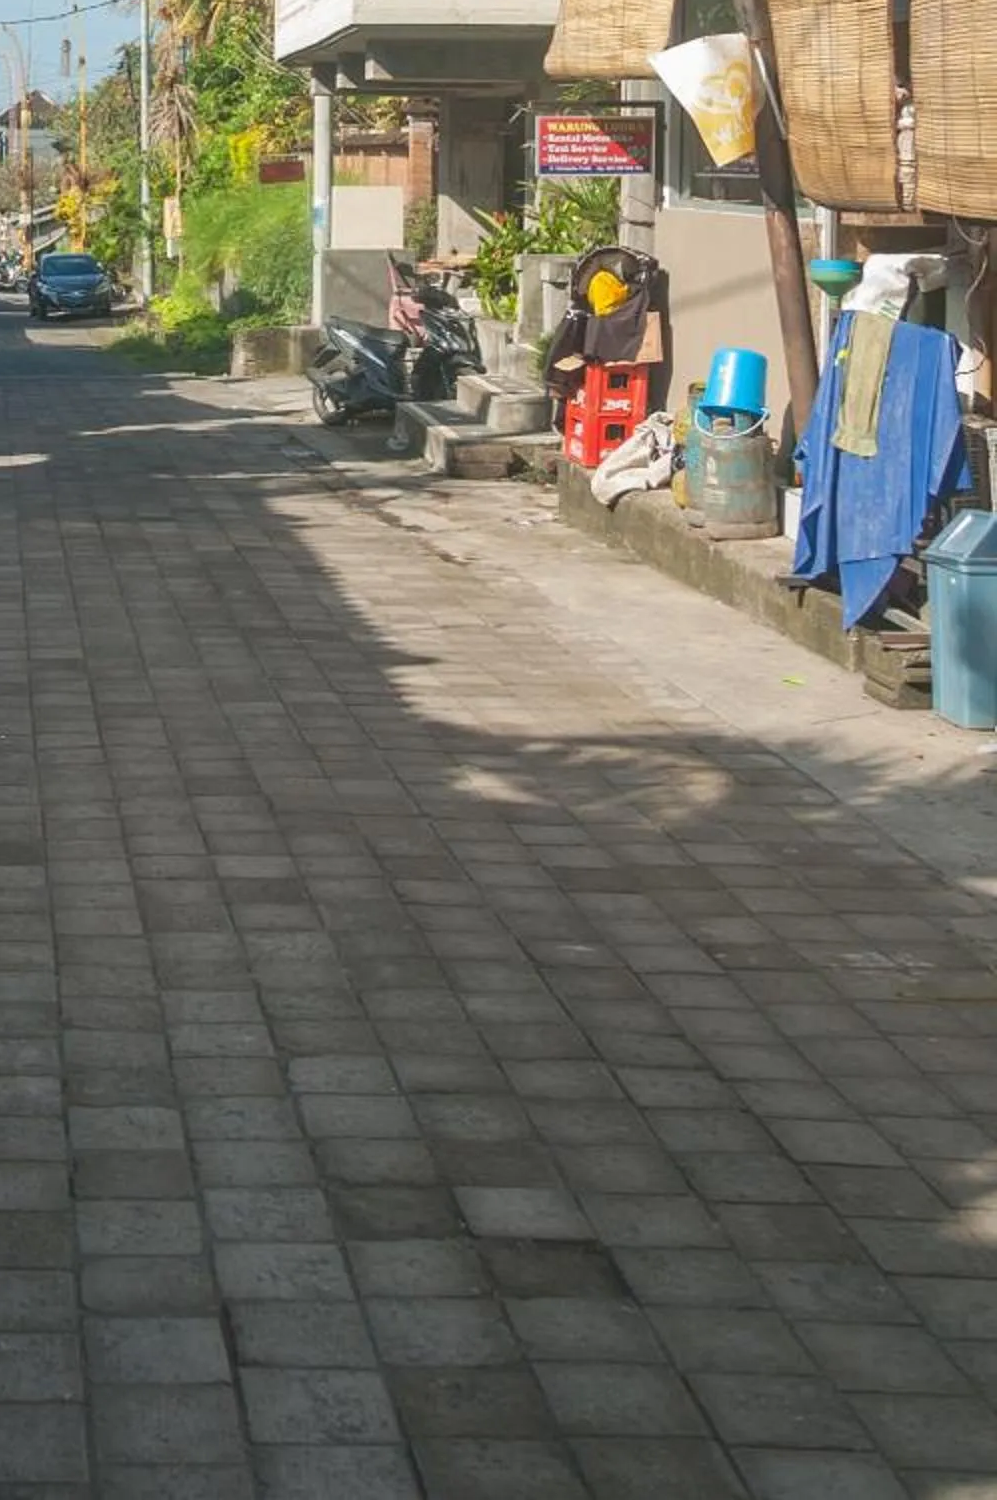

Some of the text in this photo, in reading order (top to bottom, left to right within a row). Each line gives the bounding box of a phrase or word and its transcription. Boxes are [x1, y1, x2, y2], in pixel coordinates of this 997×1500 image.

[547, 122, 600, 133] WARUNG
[548, 134, 580, 143] Rental
[572, 144, 608, 153] Service
[548, 154, 628, 165] Delivery Service
